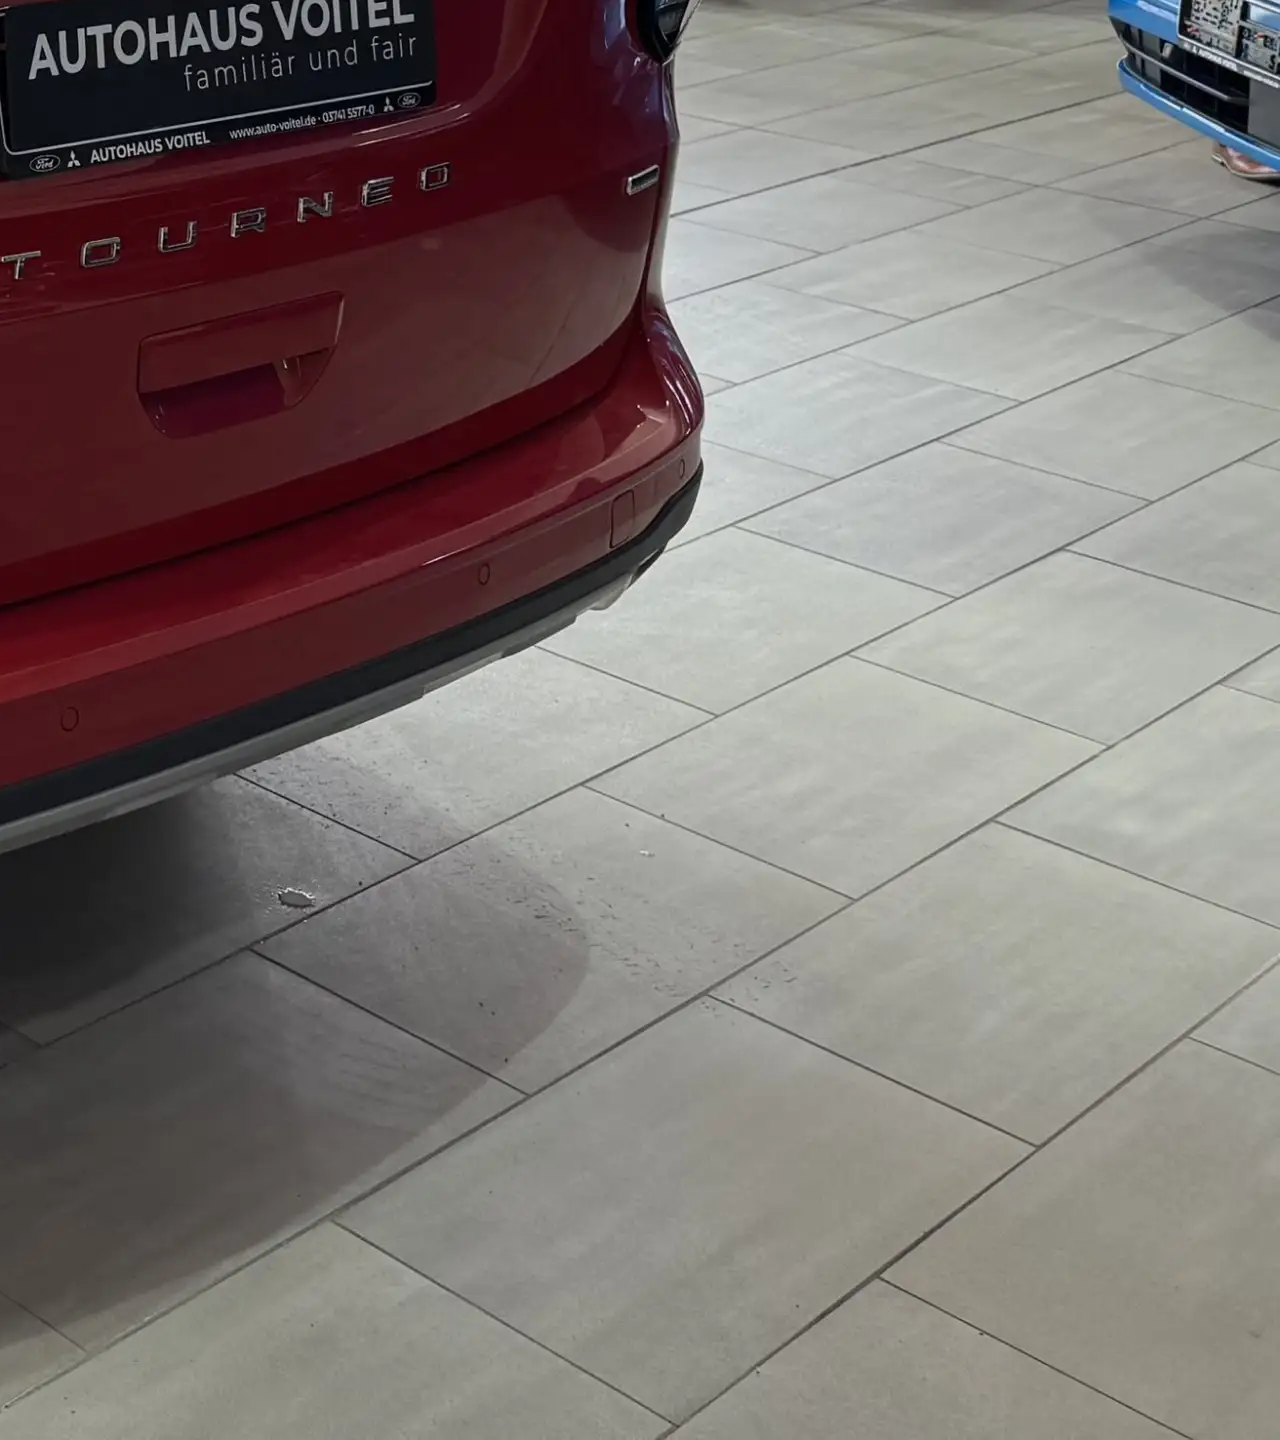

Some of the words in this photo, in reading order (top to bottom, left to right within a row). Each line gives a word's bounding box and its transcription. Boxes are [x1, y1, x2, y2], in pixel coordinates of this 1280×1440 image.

[28, 3, 264, 80] AUTOHAUS
[183, 52, 295, 92] familiär
[308, 39, 358, 71] und
[370, 33, 417, 62] fair
[229, 114, 316, 140] www.auto-voitel.de
[348, 103, 375, 119] 5577-0
[90, 138, 163, 164] AUTOHAUS
[164, 131, 211, 150] VOITEL
